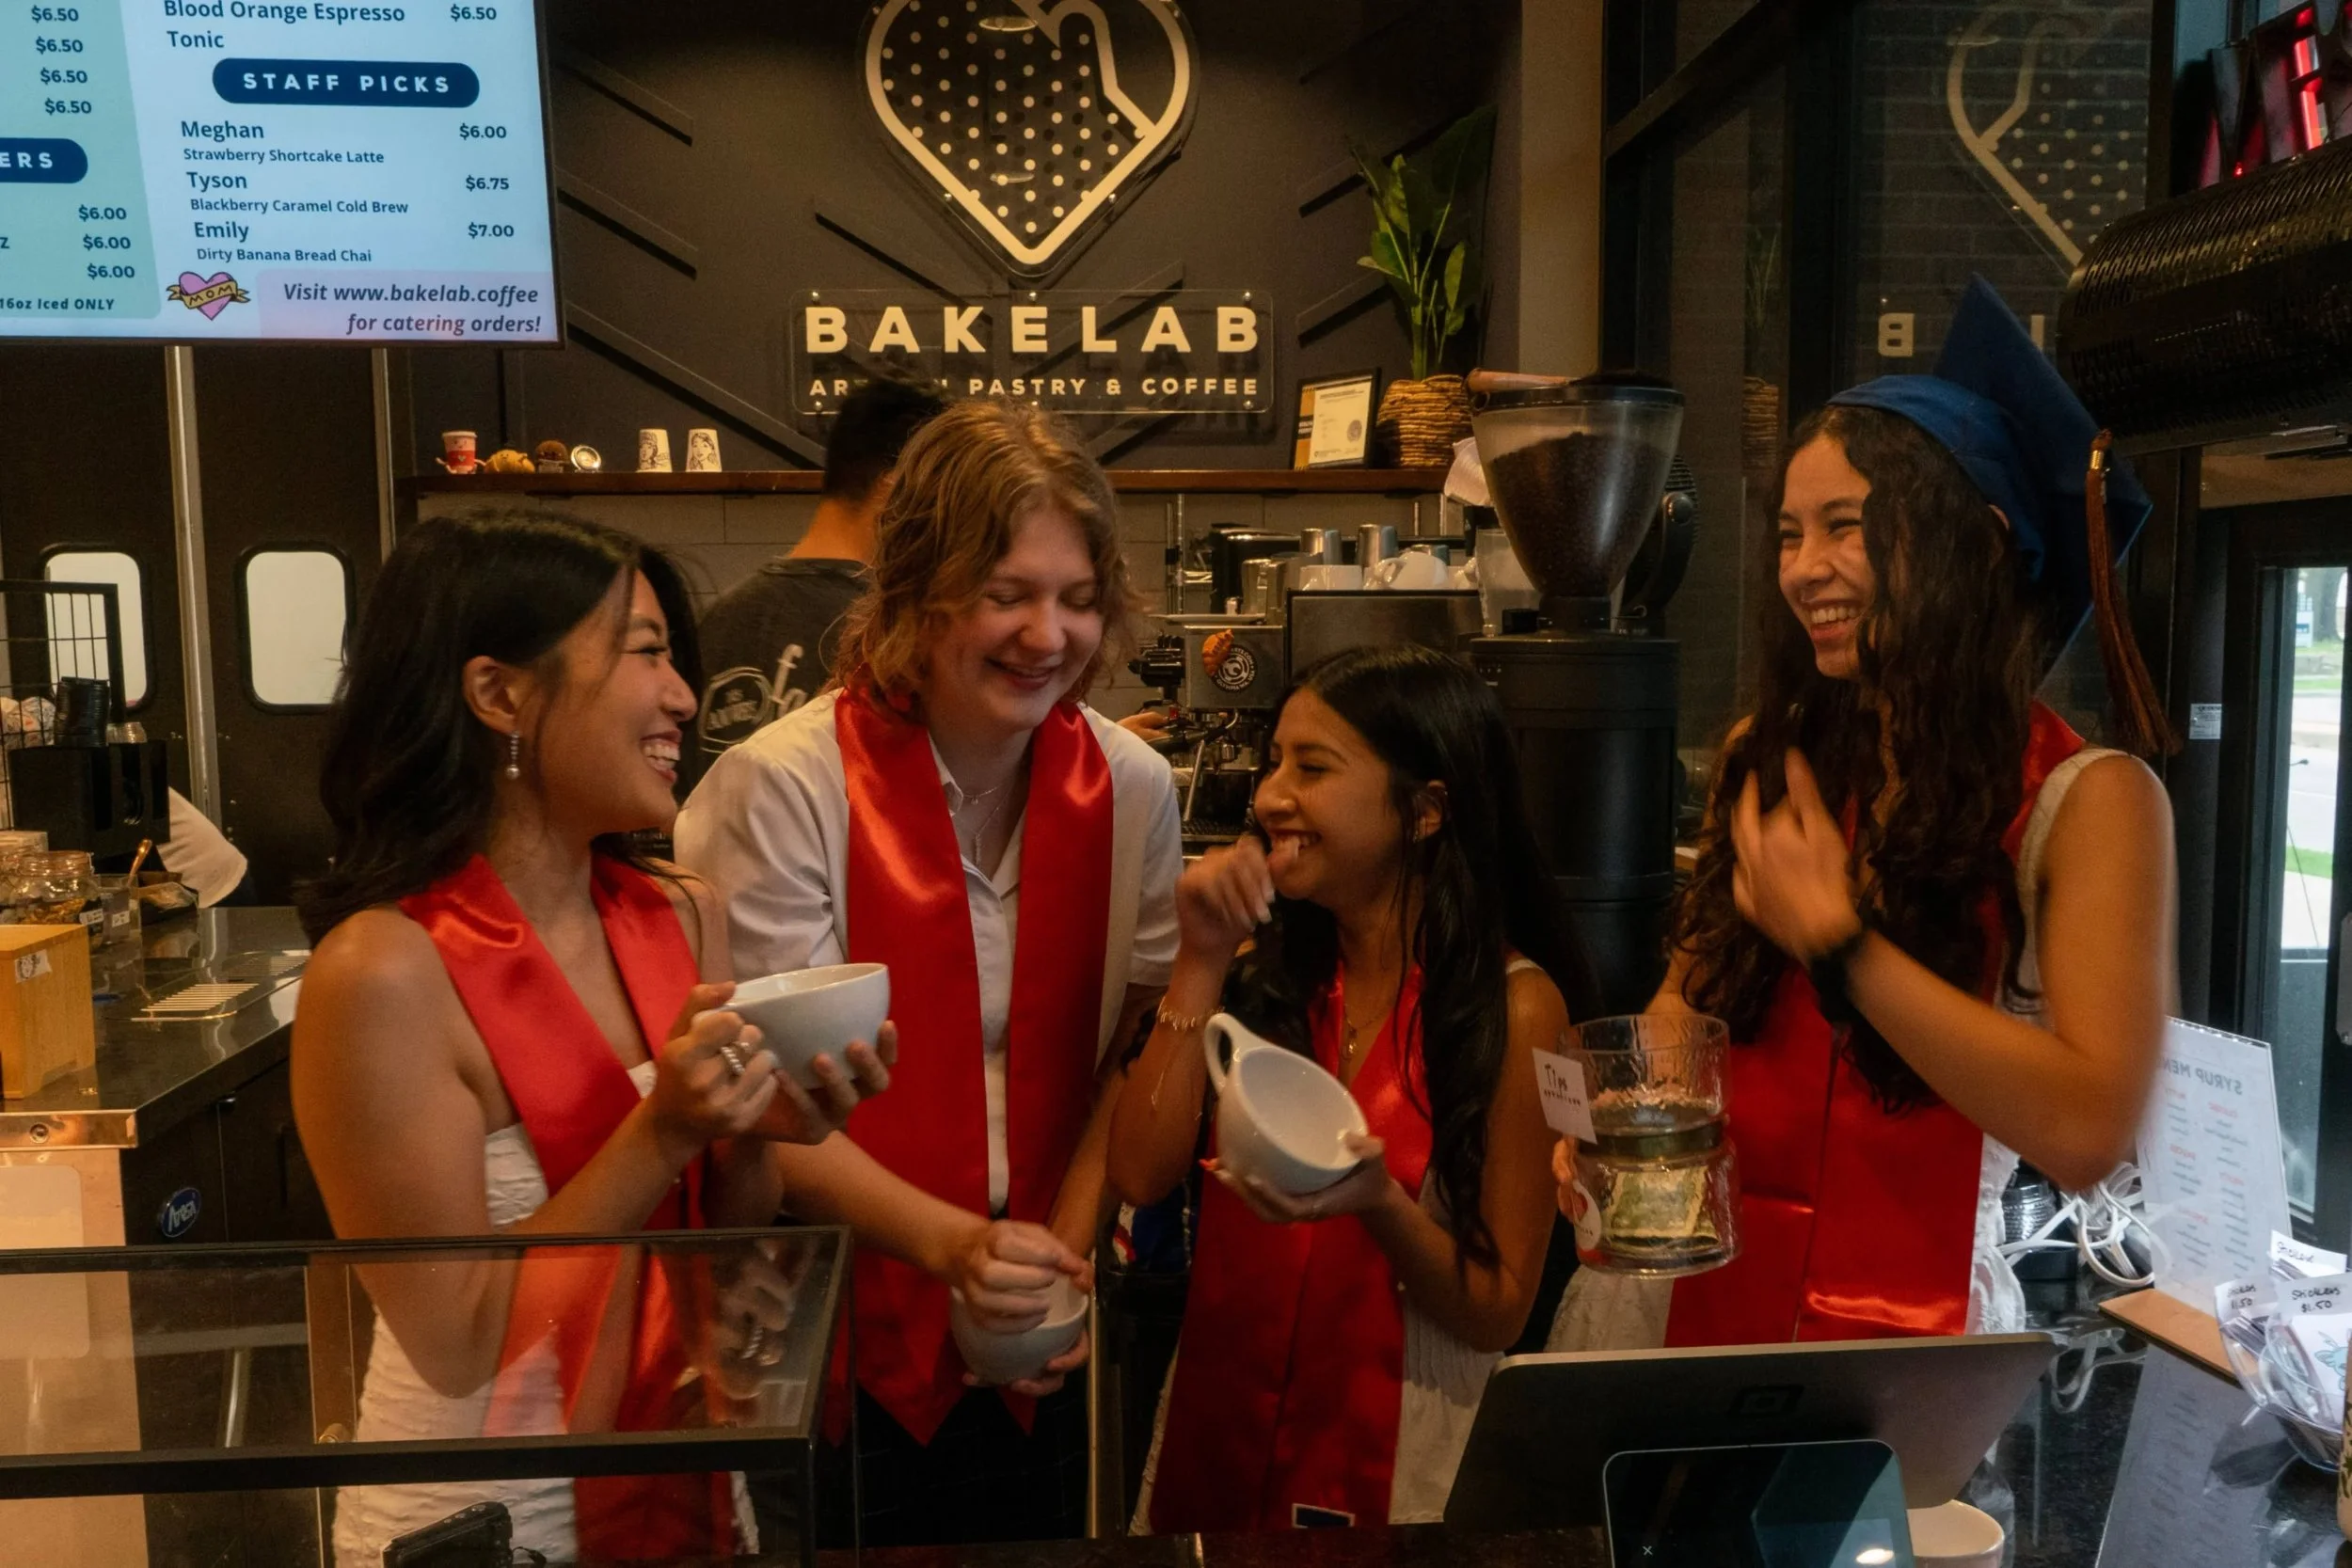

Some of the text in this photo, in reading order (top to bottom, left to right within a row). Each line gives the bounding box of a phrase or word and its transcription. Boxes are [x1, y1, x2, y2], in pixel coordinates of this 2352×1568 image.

[31, 5, 79, 24] $6.50
[164, 0, 498, 25] Blood Orange Espresso $6.50
[35, 36, 84, 55] $6.50
[167, 30, 225, 48] Tonic
[40, 67, 88, 86] $6.50
[243, 72, 449, 93] STAFF PICKS
[44, 97, 92, 116] $6.50
[181, 119, 507, 143] Meghan $6.00
[0, 151, 53, 169] ERS
[183, 148, 385, 165] Strawberry Shortcake Latte
[185, 171, 510, 193] Tyson $6.75
[78, 204, 127, 222] $6.00
[190, 198, 408, 214] Blackberry Caramel Cold Brew
[82, 233, 132, 251] $6.00
[194, 221, 515, 244] Emily $7.00
[197, 248, 372, 263] Dirty Banana Bread Chai
[87, 262, 135, 280] $6.00
[38, 297, 69, 310] Iced
[73, 298, 115, 310] ONLY
[189, 284, 233, 306] MOM
[283, 282, 539, 308] Visit www.bakelab.coffee
[345, 313, 541, 337] for catering orders!
[969, 378, 1086, 396] PASTRY
[1105, 378, 1121, 396] &
[1141, 377, 1257, 395] COFFEE
